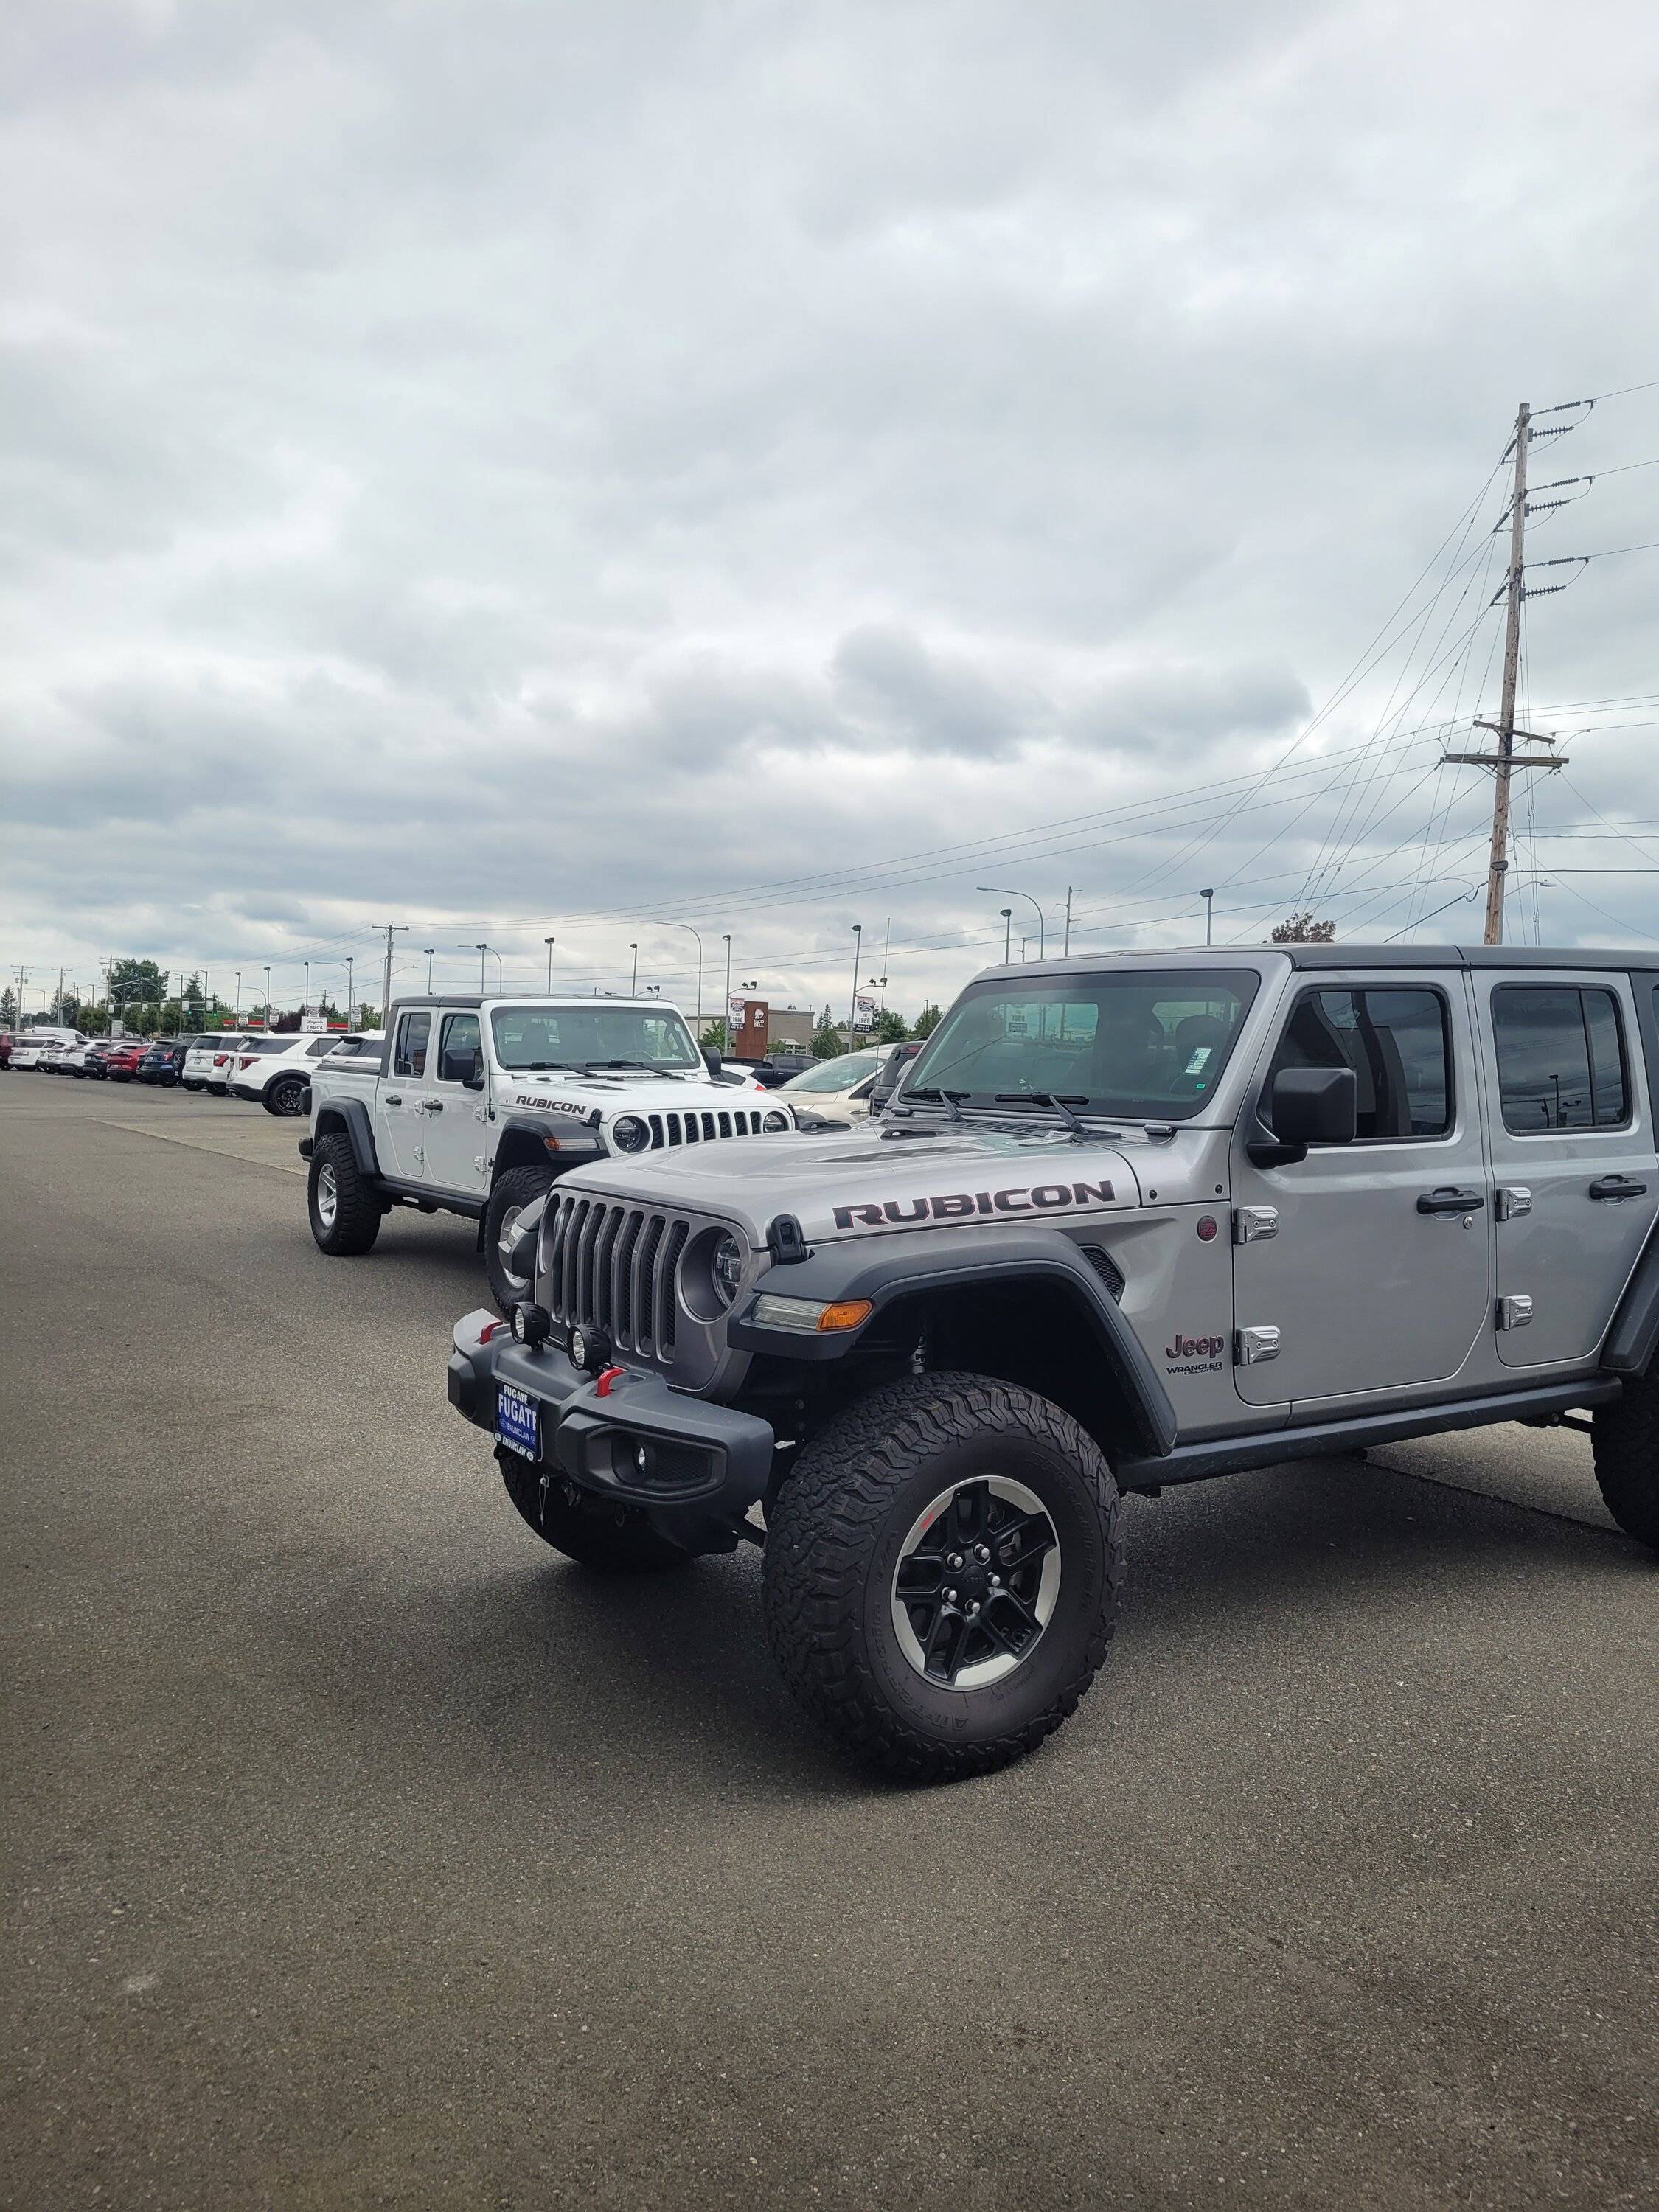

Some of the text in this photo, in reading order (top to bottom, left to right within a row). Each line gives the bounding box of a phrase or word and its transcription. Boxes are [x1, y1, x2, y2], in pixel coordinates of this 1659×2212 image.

[516, 1095, 587, 1115] RUBICON
[832, 1180, 1116, 1229] RUBICON
[1166, 1333, 1224, 1358] Jeep
[1166, 1361, 1222, 1374] WRANGLER
[1184, 1367, 1222, 1375] UNLIMITED
[504, 1384, 528, 1405] FUGATE
[503, 1436, 526, 1456] ENUMCLAW
